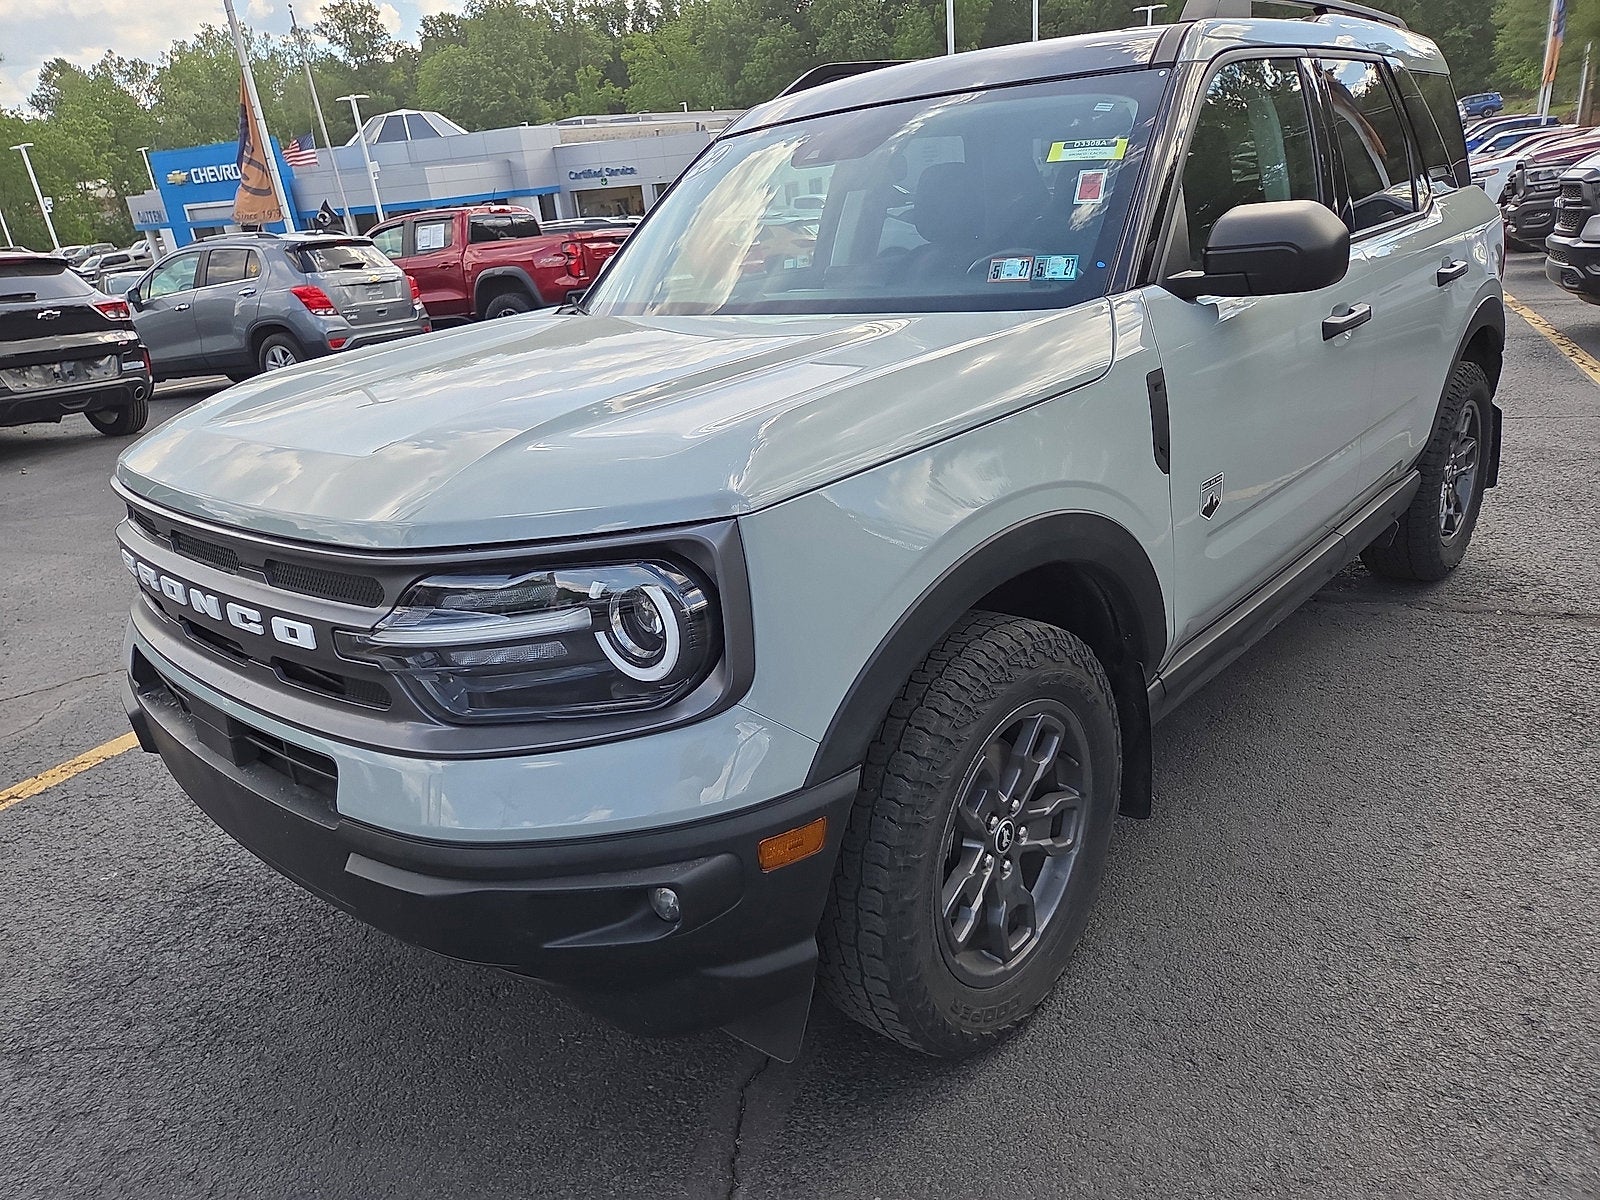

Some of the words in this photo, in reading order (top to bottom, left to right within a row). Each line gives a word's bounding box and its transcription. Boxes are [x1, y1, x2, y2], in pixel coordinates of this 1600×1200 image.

[568, 168, 603, 179] Certified
[604, 165, 637, 177] Service
[235, 211, 258, 220] Since
[992, 264, 1000, 279] 5
[1018, 260, 1030, 278] 27
[1036, 262, 1044, 277] 5
[1063, 258, 1075, 276] 27
[121, 549, 317, 650] BRONCO
